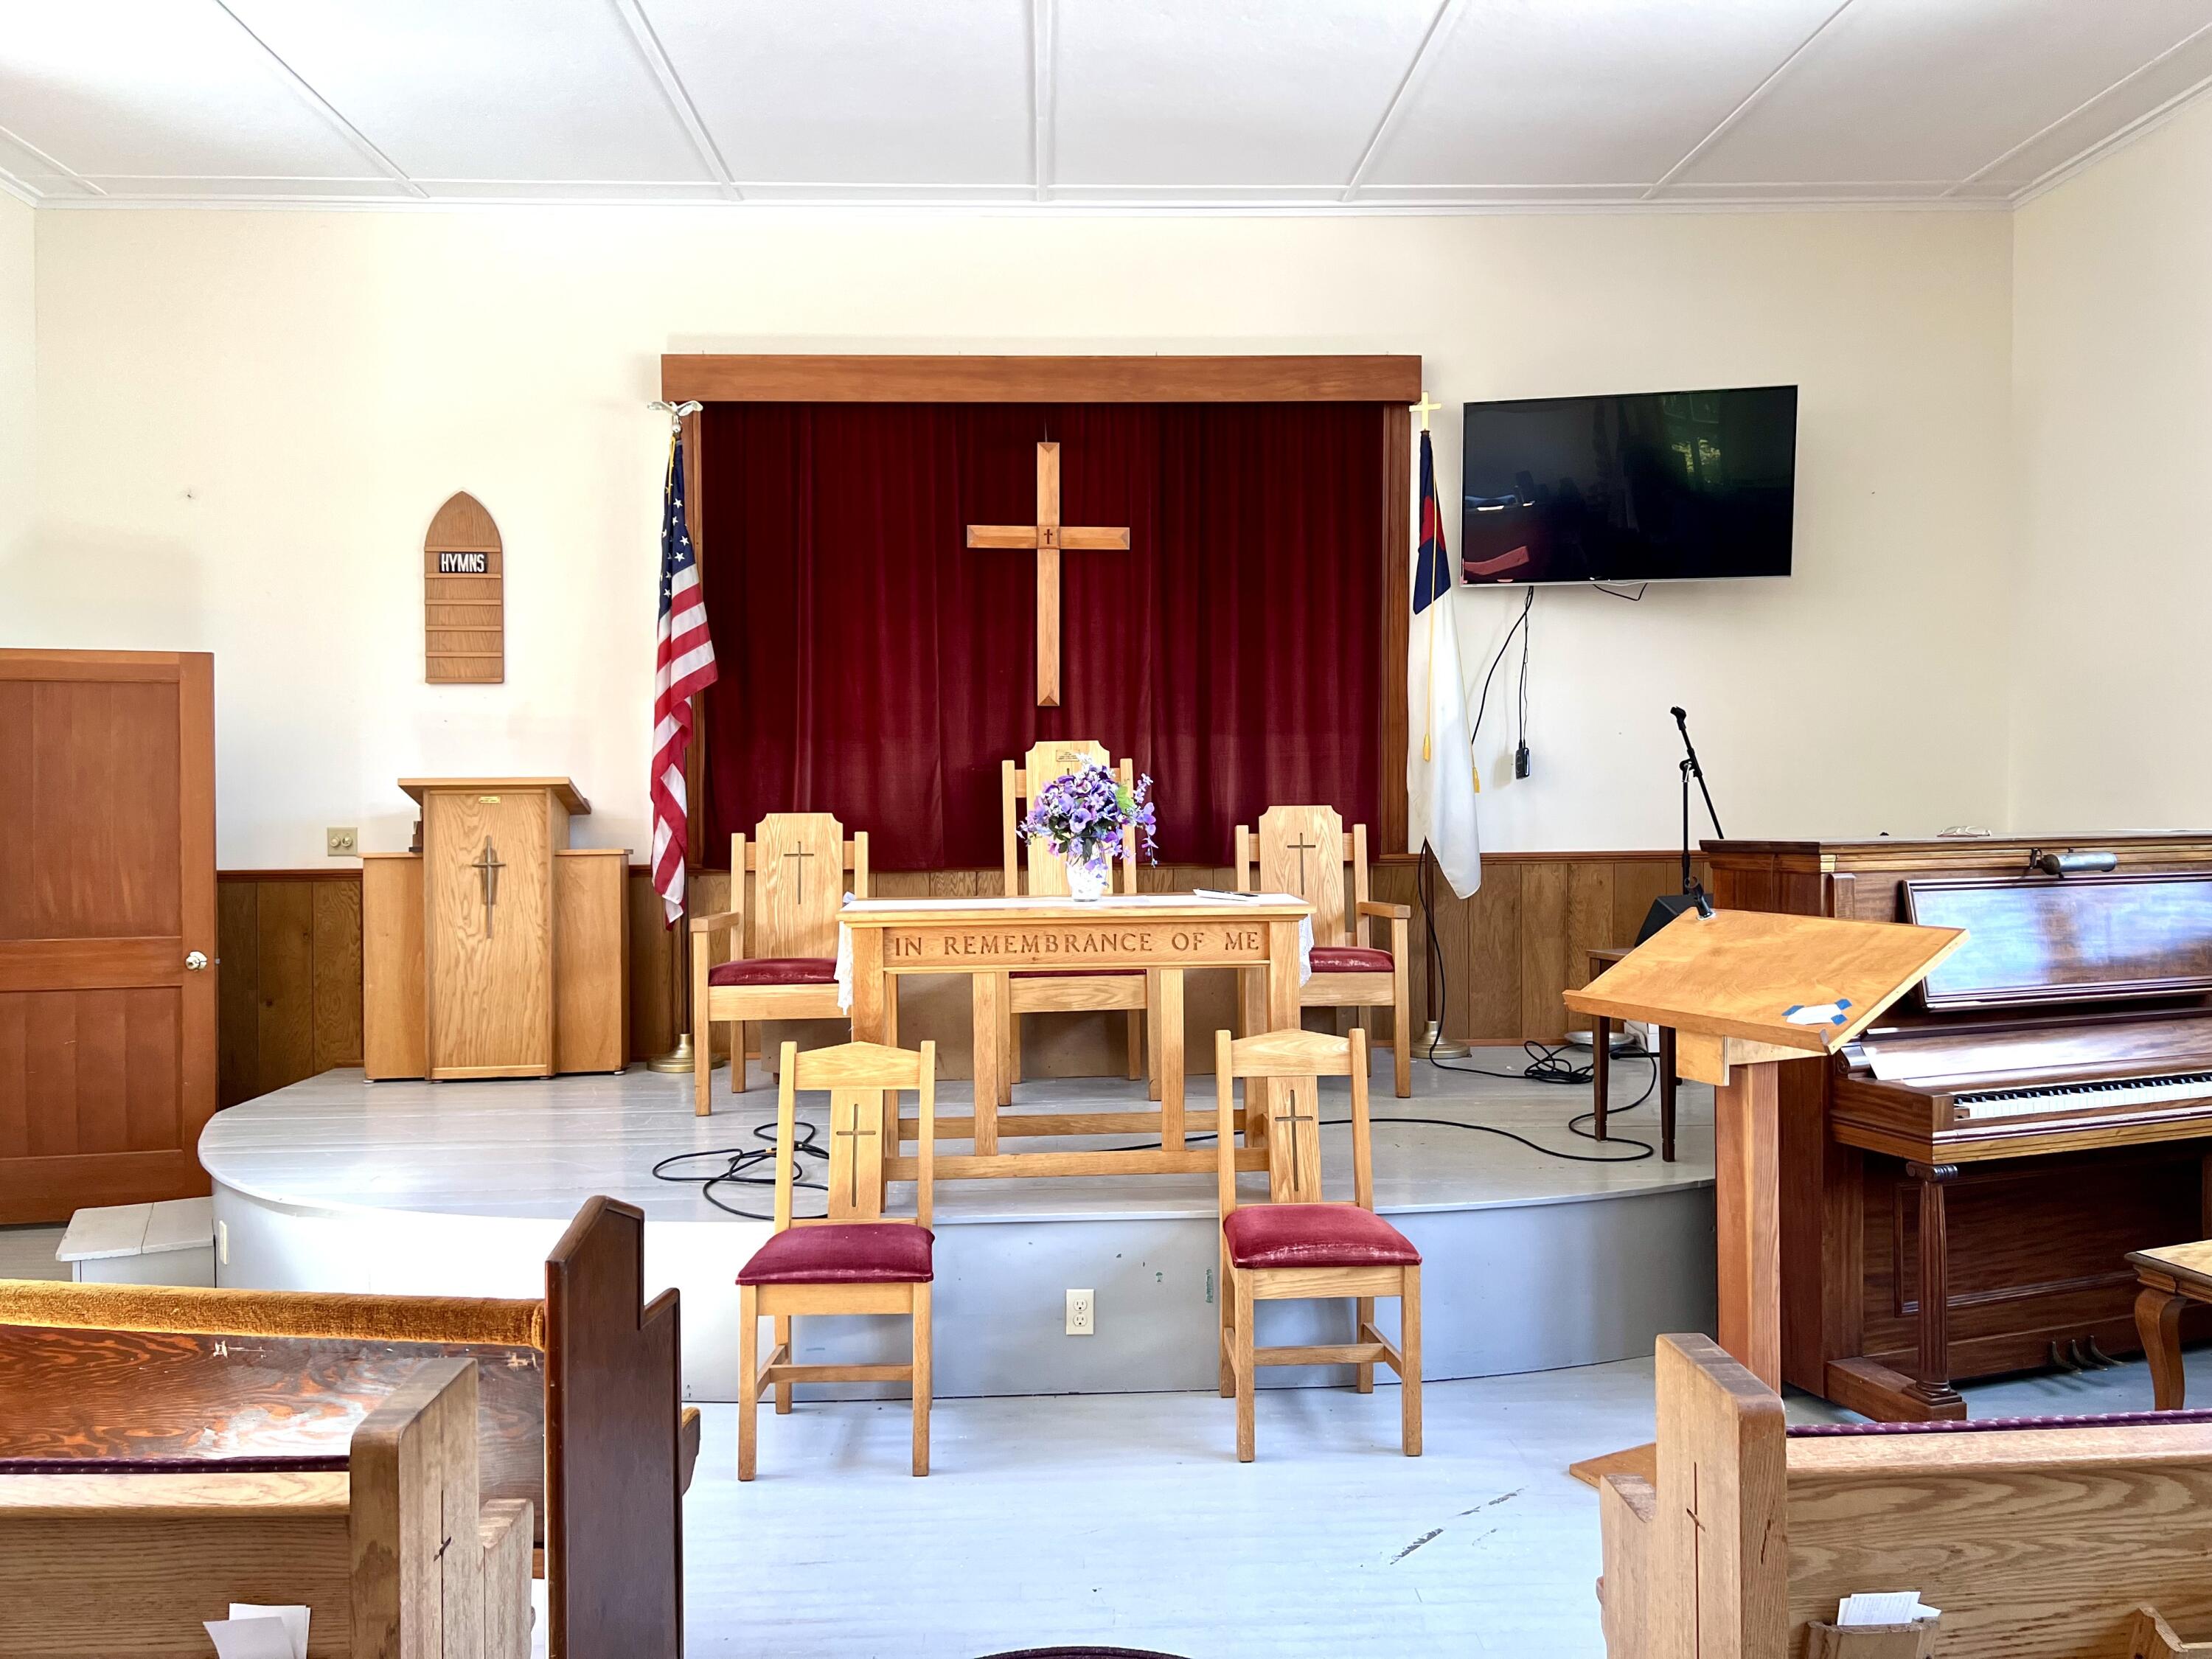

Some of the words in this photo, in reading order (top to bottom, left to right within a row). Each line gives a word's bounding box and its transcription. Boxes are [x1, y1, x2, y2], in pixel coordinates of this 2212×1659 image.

[441, 553, 485, 572] HYMNS
[895, 936, 922, 956] IN
[944, 933, 1152, 956] REMEMBRANCE
[1171, 932, 1205, 952] OF
[1224, 931, 1259, 951] ME
